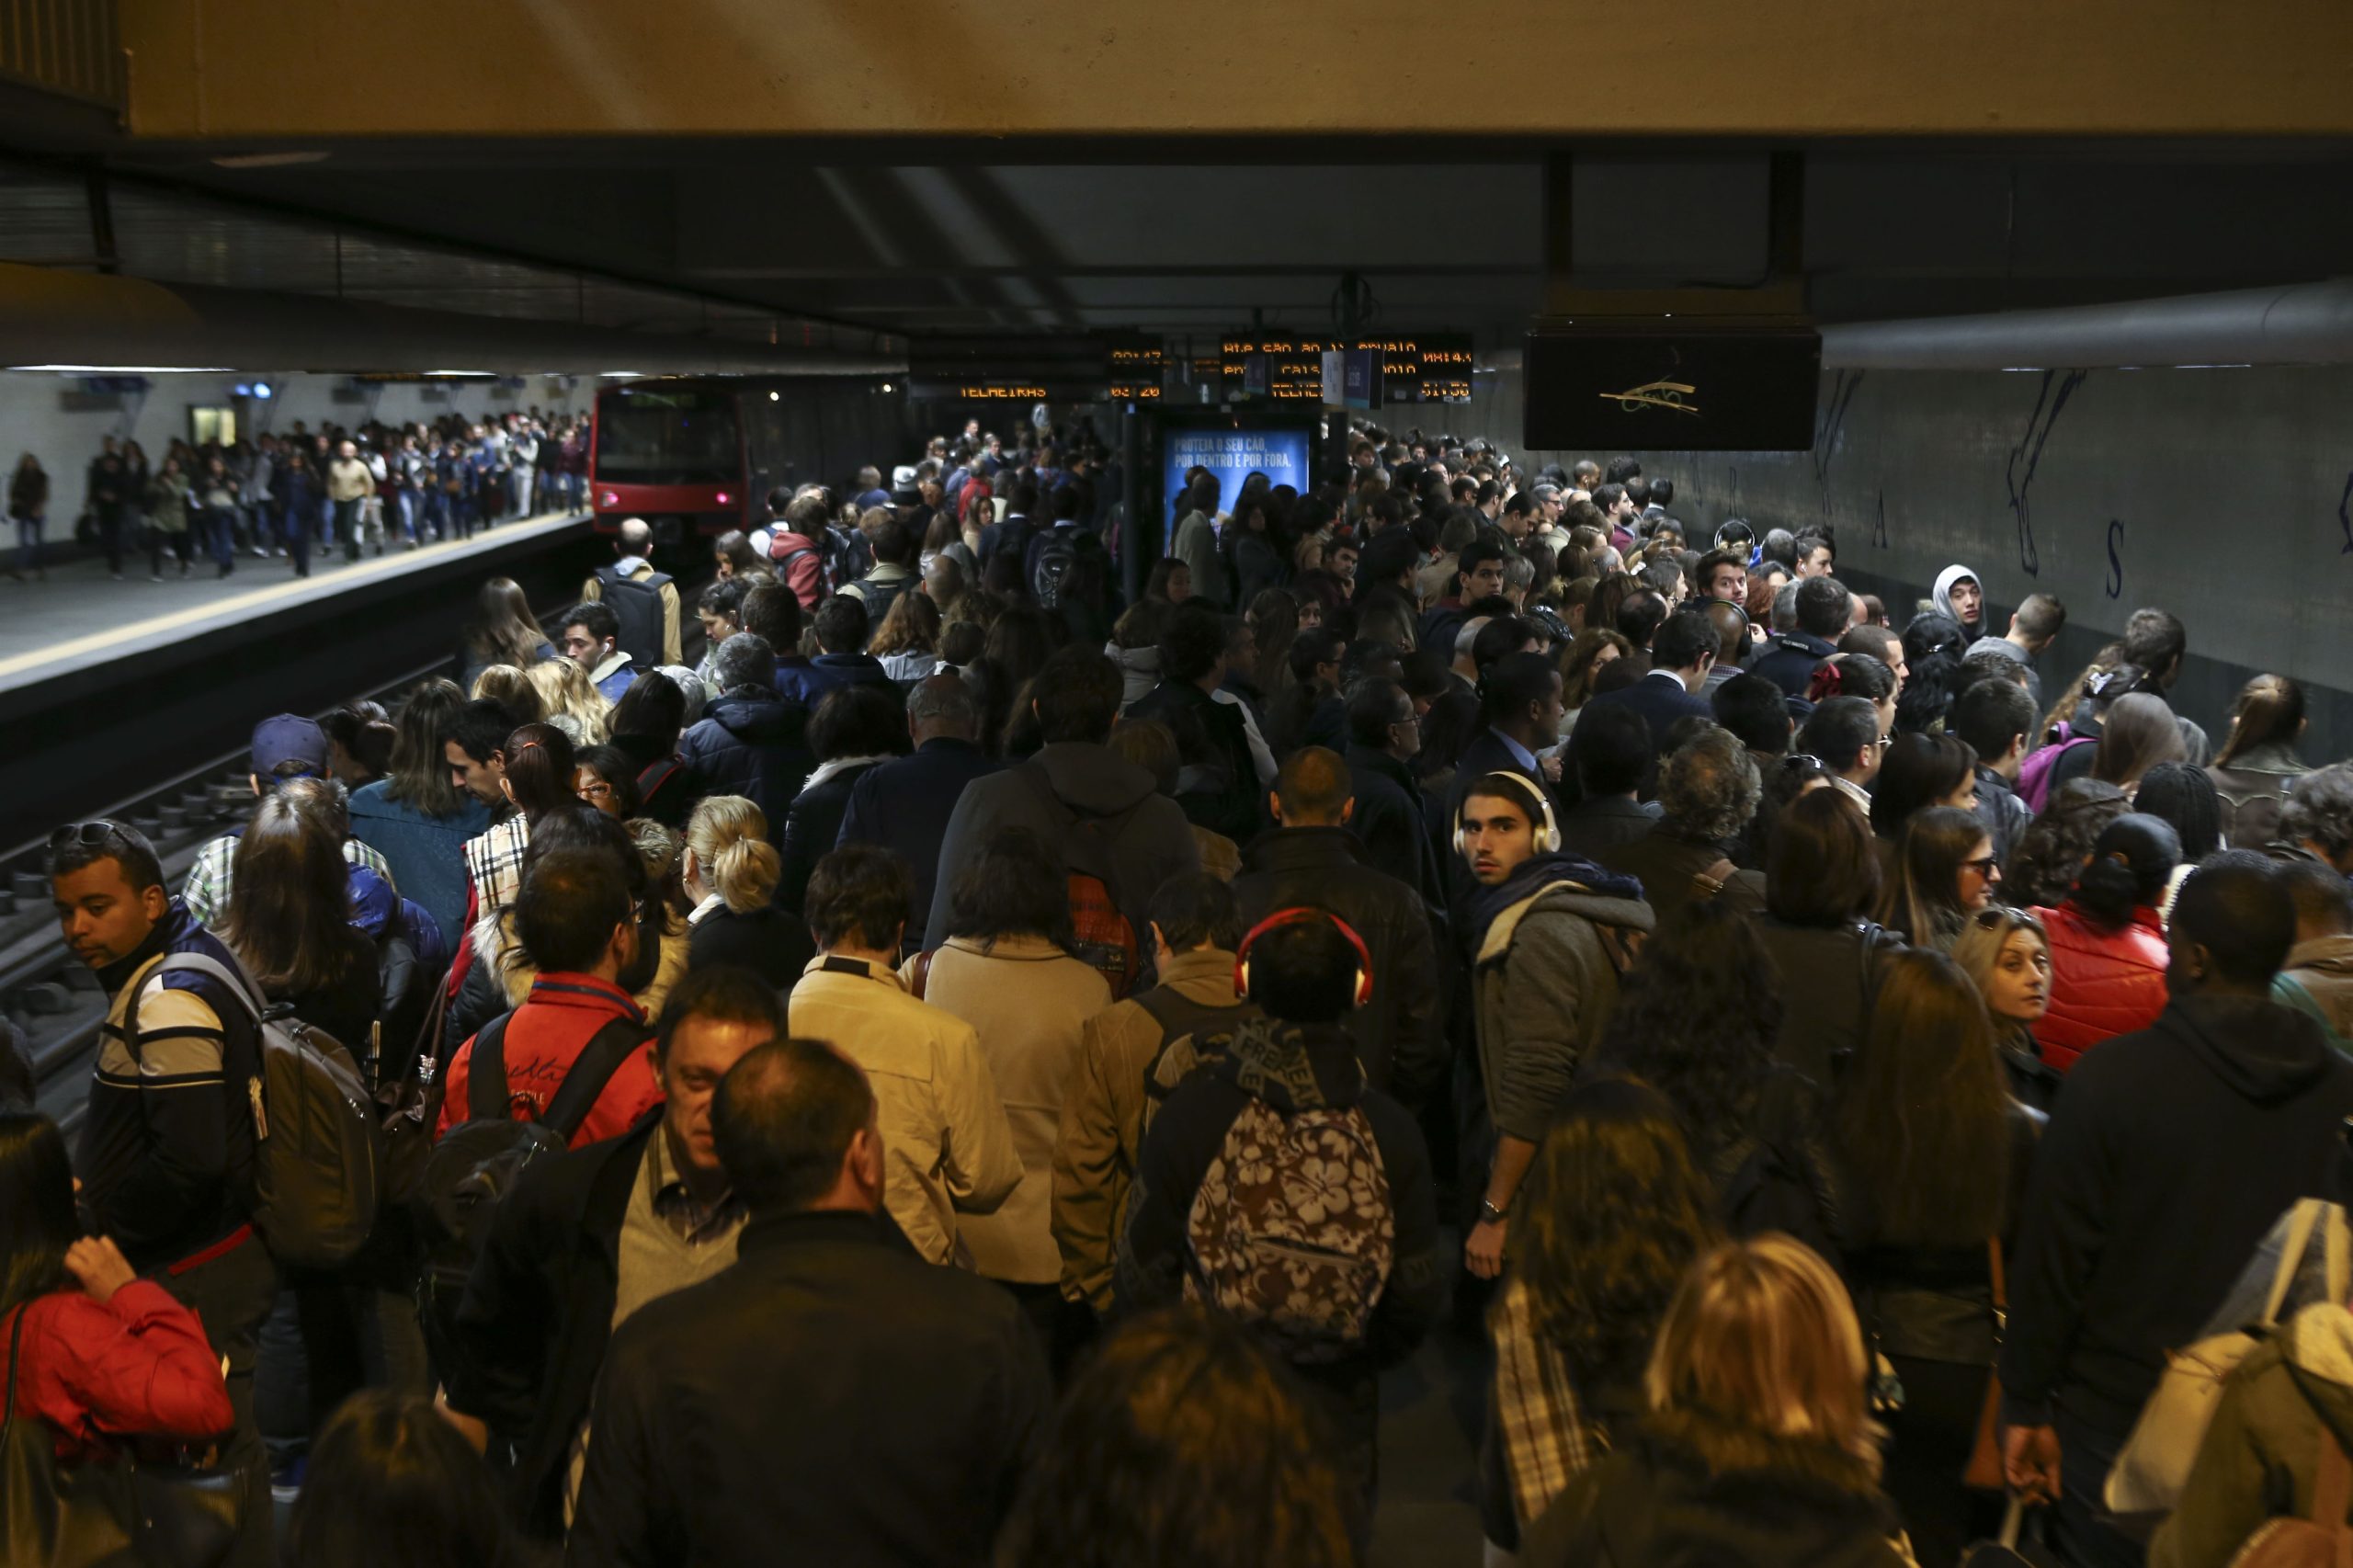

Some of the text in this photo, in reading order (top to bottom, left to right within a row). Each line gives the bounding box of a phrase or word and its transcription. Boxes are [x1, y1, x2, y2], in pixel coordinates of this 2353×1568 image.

[1175, 438, 1214, 451] PROTEJA
[1217, 438, 1223, 451] O
[1225, 438, 1244, 451] SEU
[1175, 454, 1291, 468] POR DENTRO E POR FORA.
[2106, 519, 2124, 598] S
